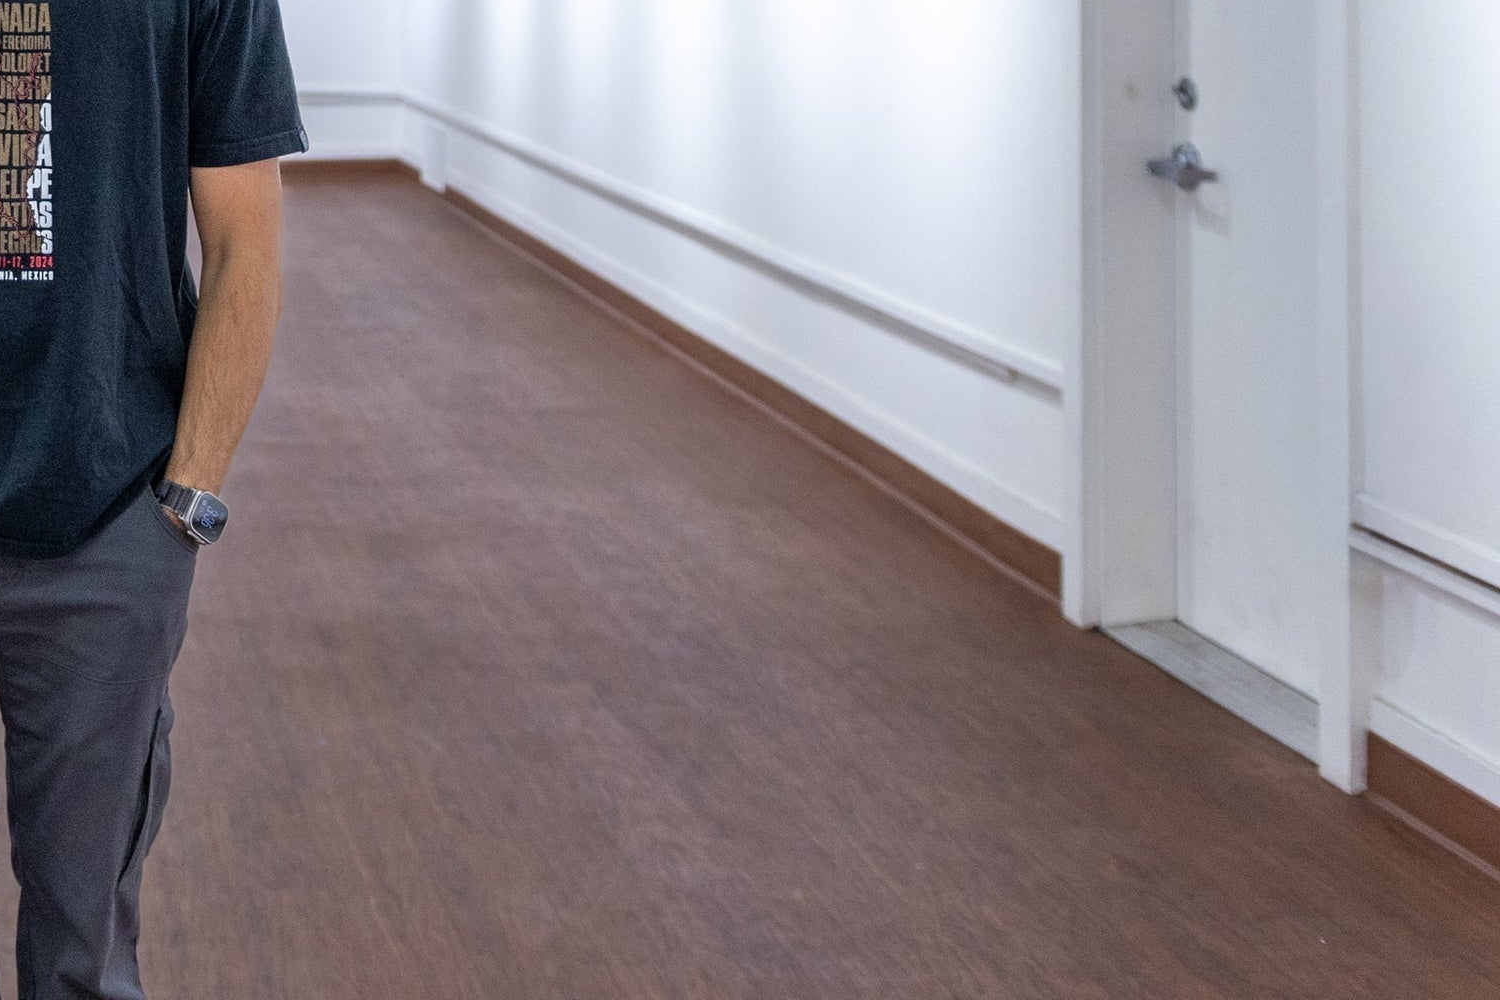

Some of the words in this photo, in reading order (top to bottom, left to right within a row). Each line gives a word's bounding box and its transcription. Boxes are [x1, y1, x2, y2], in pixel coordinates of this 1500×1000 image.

[2, 34, 51, 50] ERENDIRA
[29, 256, 53, 268] 2024
[21, 271, 54, 280] MEXICO
